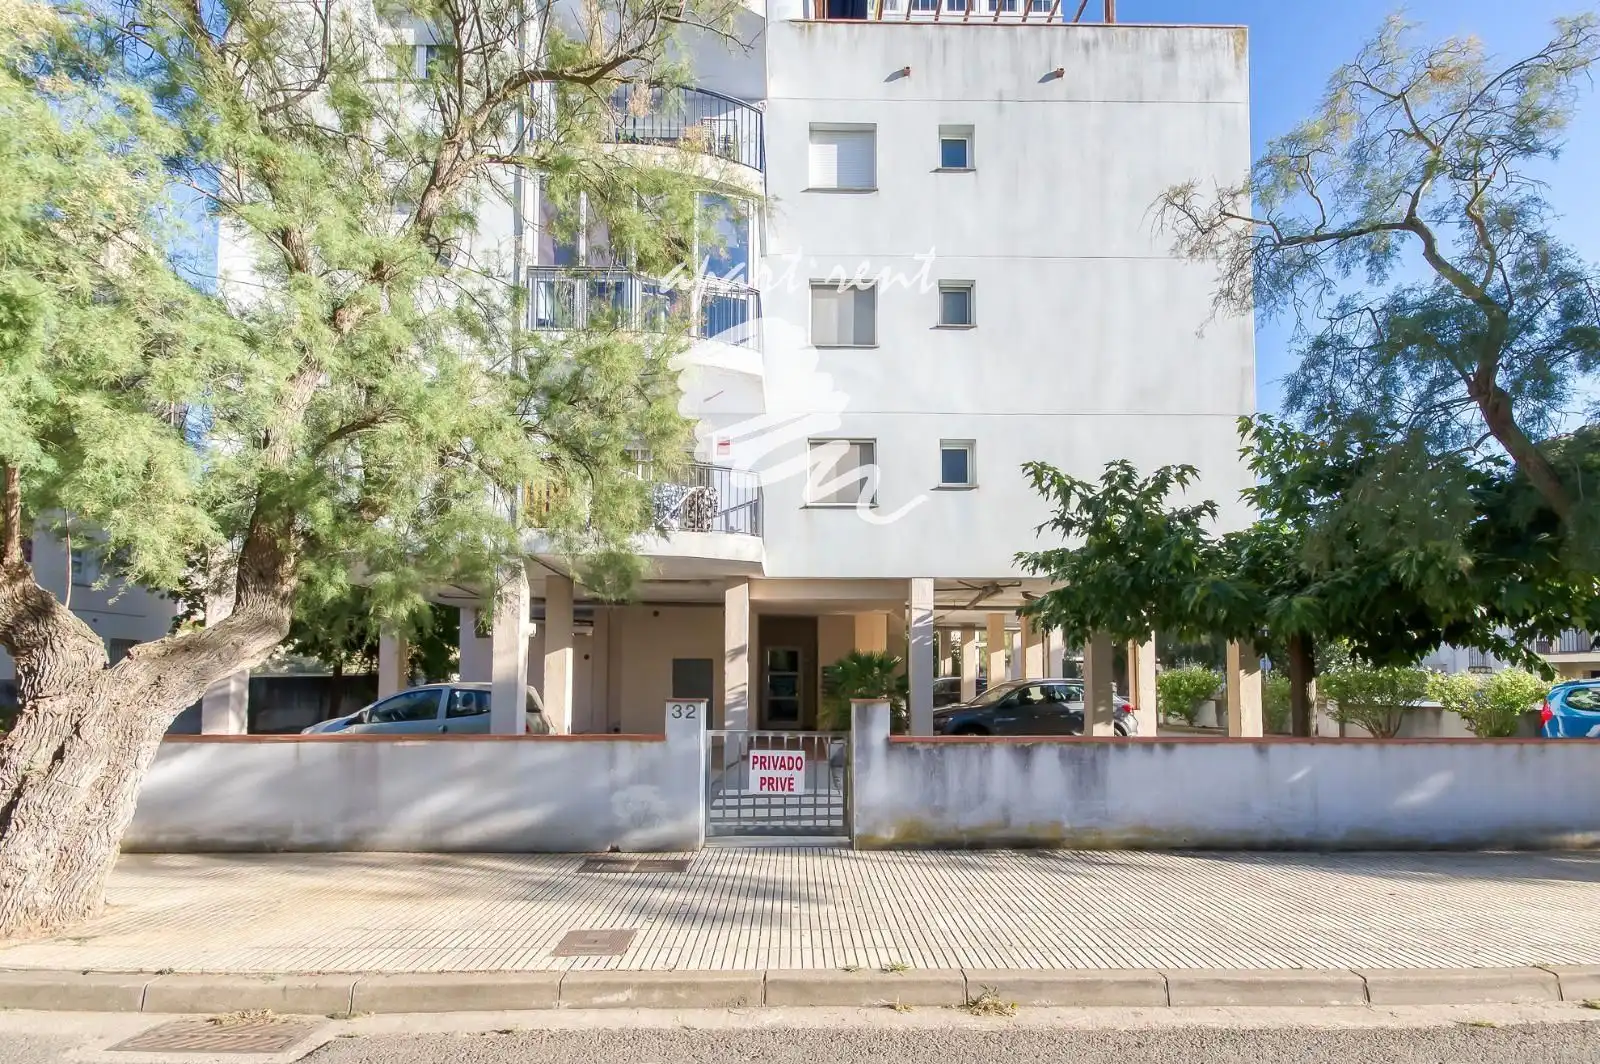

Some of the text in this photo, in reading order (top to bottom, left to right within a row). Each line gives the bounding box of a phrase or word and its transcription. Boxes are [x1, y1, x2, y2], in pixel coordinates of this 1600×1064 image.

[671, 704, 696, 719] 32
[752, 755, 803, 771] PRIVADO
[760, 773, 794, 792] PRIVÉ
